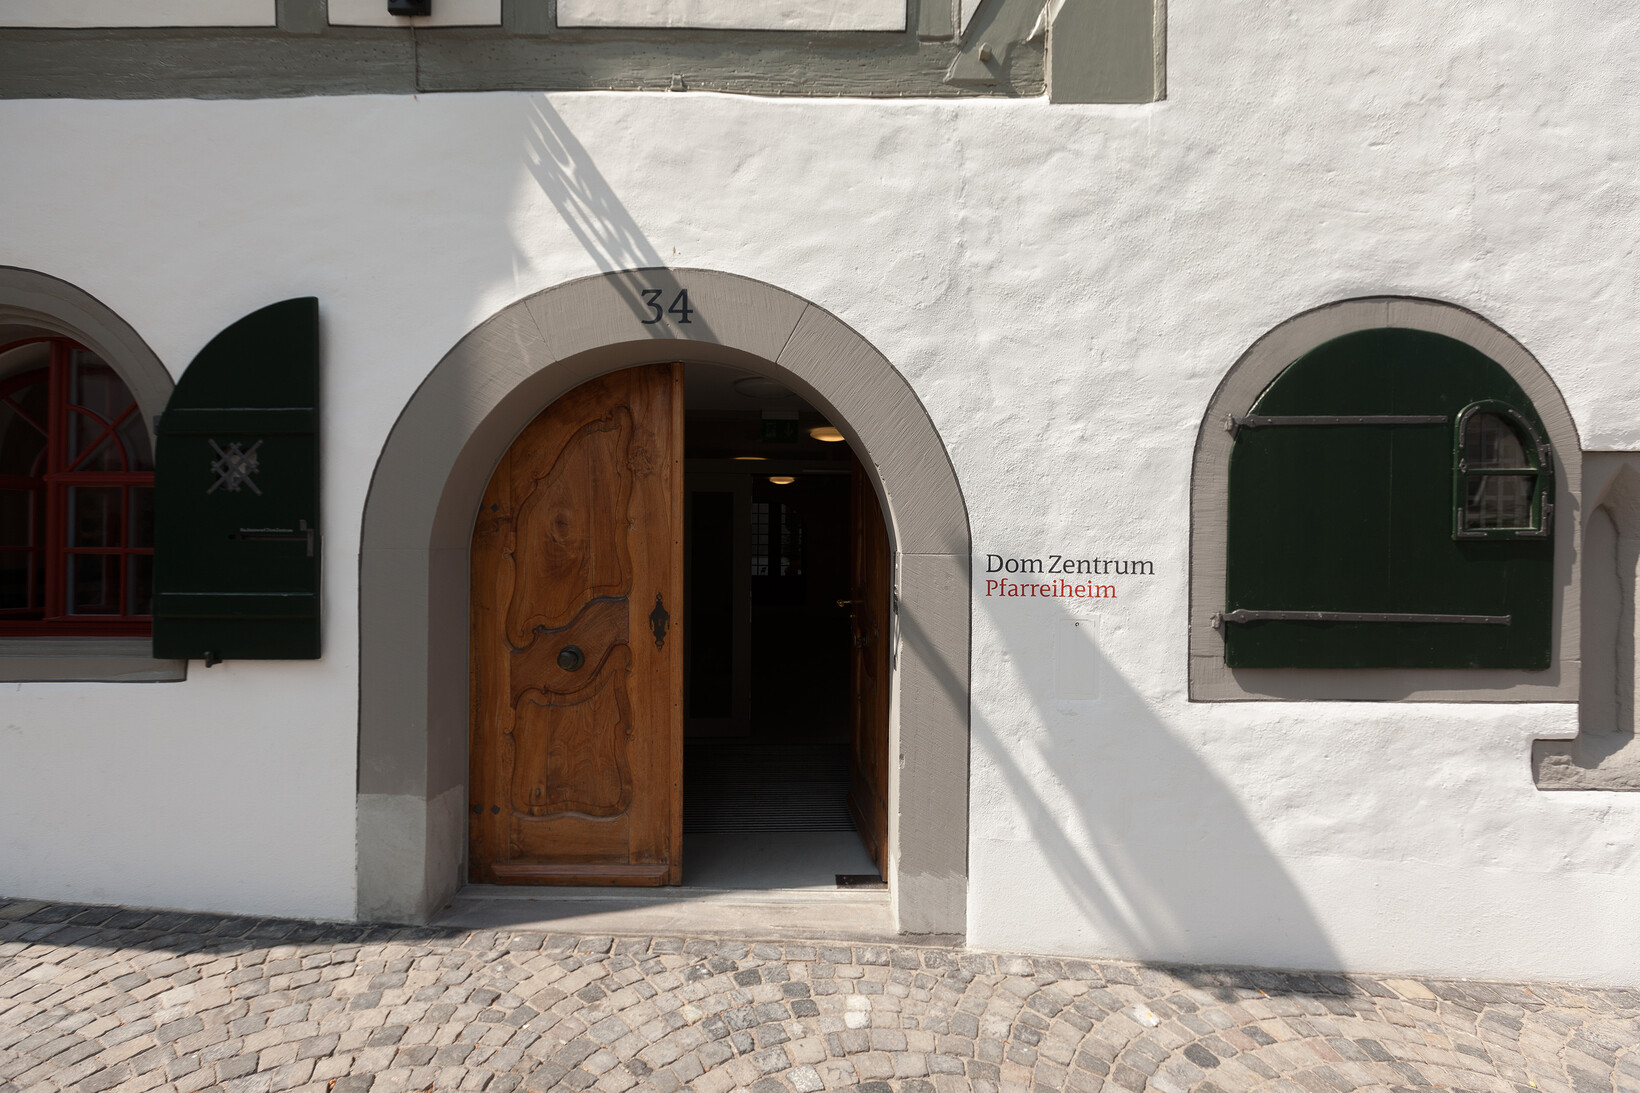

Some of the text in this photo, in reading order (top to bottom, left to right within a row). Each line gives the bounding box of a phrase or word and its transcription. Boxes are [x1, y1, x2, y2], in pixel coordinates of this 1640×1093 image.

[641, 289, 693, 325] 34
[986, 554, 1155, 575] Dom Zentrum
[985, 578, 1117, 598] Pfarreiheim
